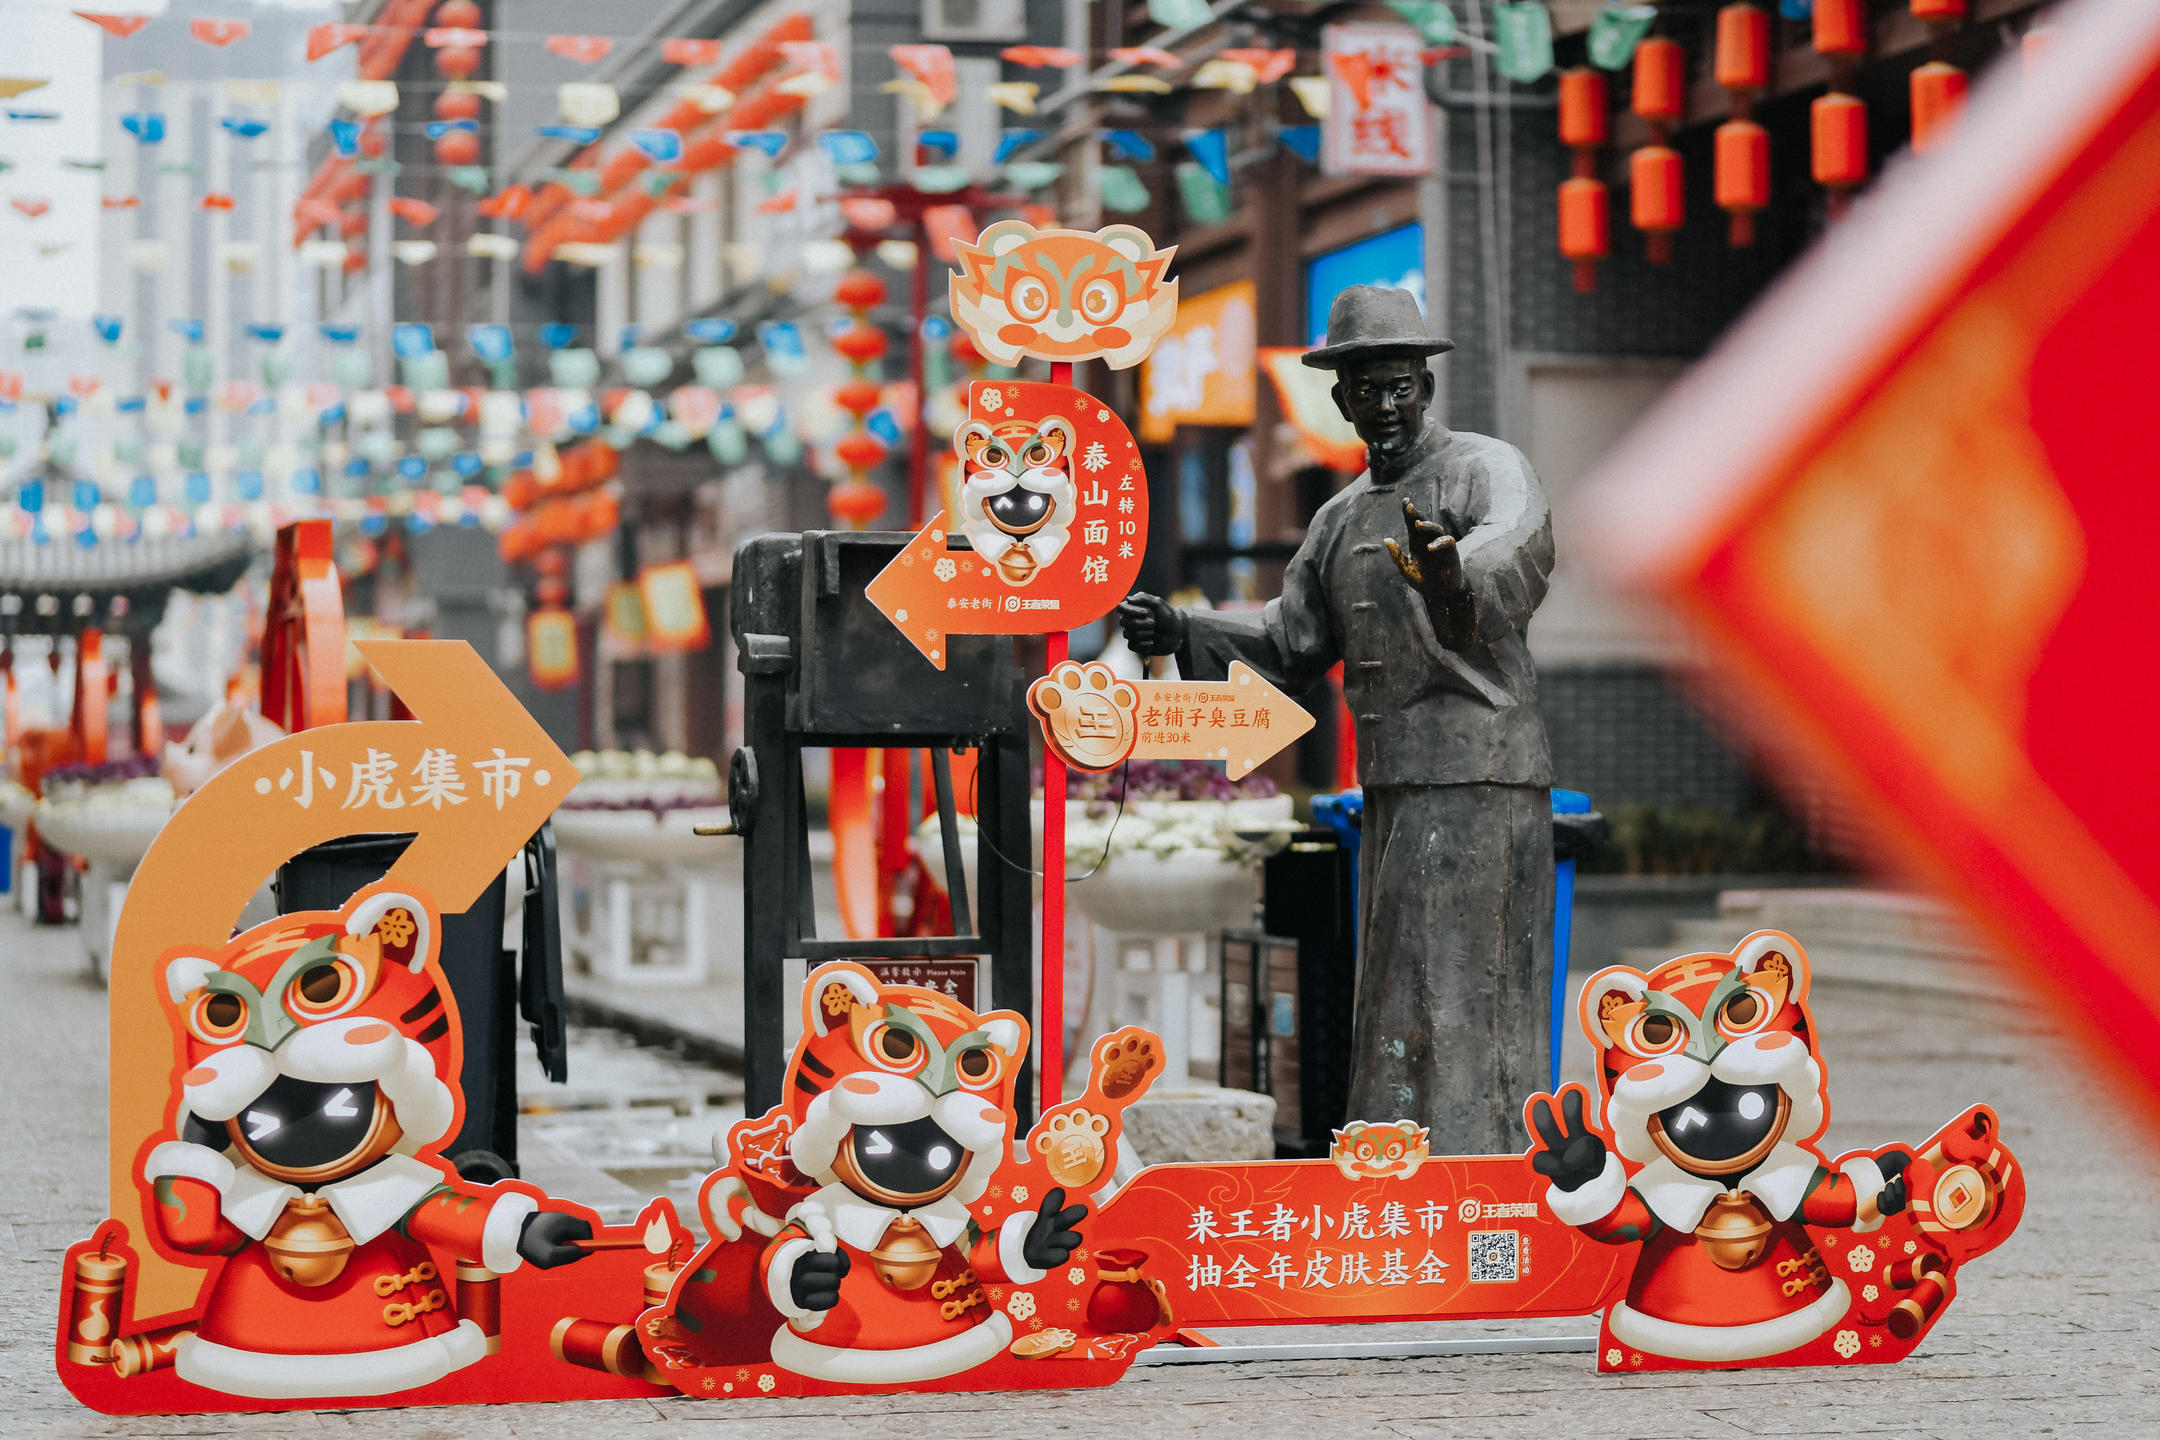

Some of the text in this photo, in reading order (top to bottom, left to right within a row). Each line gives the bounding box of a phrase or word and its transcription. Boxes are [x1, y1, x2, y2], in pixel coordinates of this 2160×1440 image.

[1081, 441, 1111, 584] 泰山面馆
[1118, 473, 1136, 560] 左转10米
[947, 597, 993, 609] 泰安老街
[1141, 706, 1272, 730] 老铺子臭豆腐
[1141, 731, 1192, 744] 前进30米
[279, 747, 532, 811] 小虎集市
[1186, 1200, 1449, 1245] 来王者小虎集市
[1481, 1203, 1538, 1218] 王者荣耀
[1185, 1247, 1451, 1292] 抽全年皮肤基金
